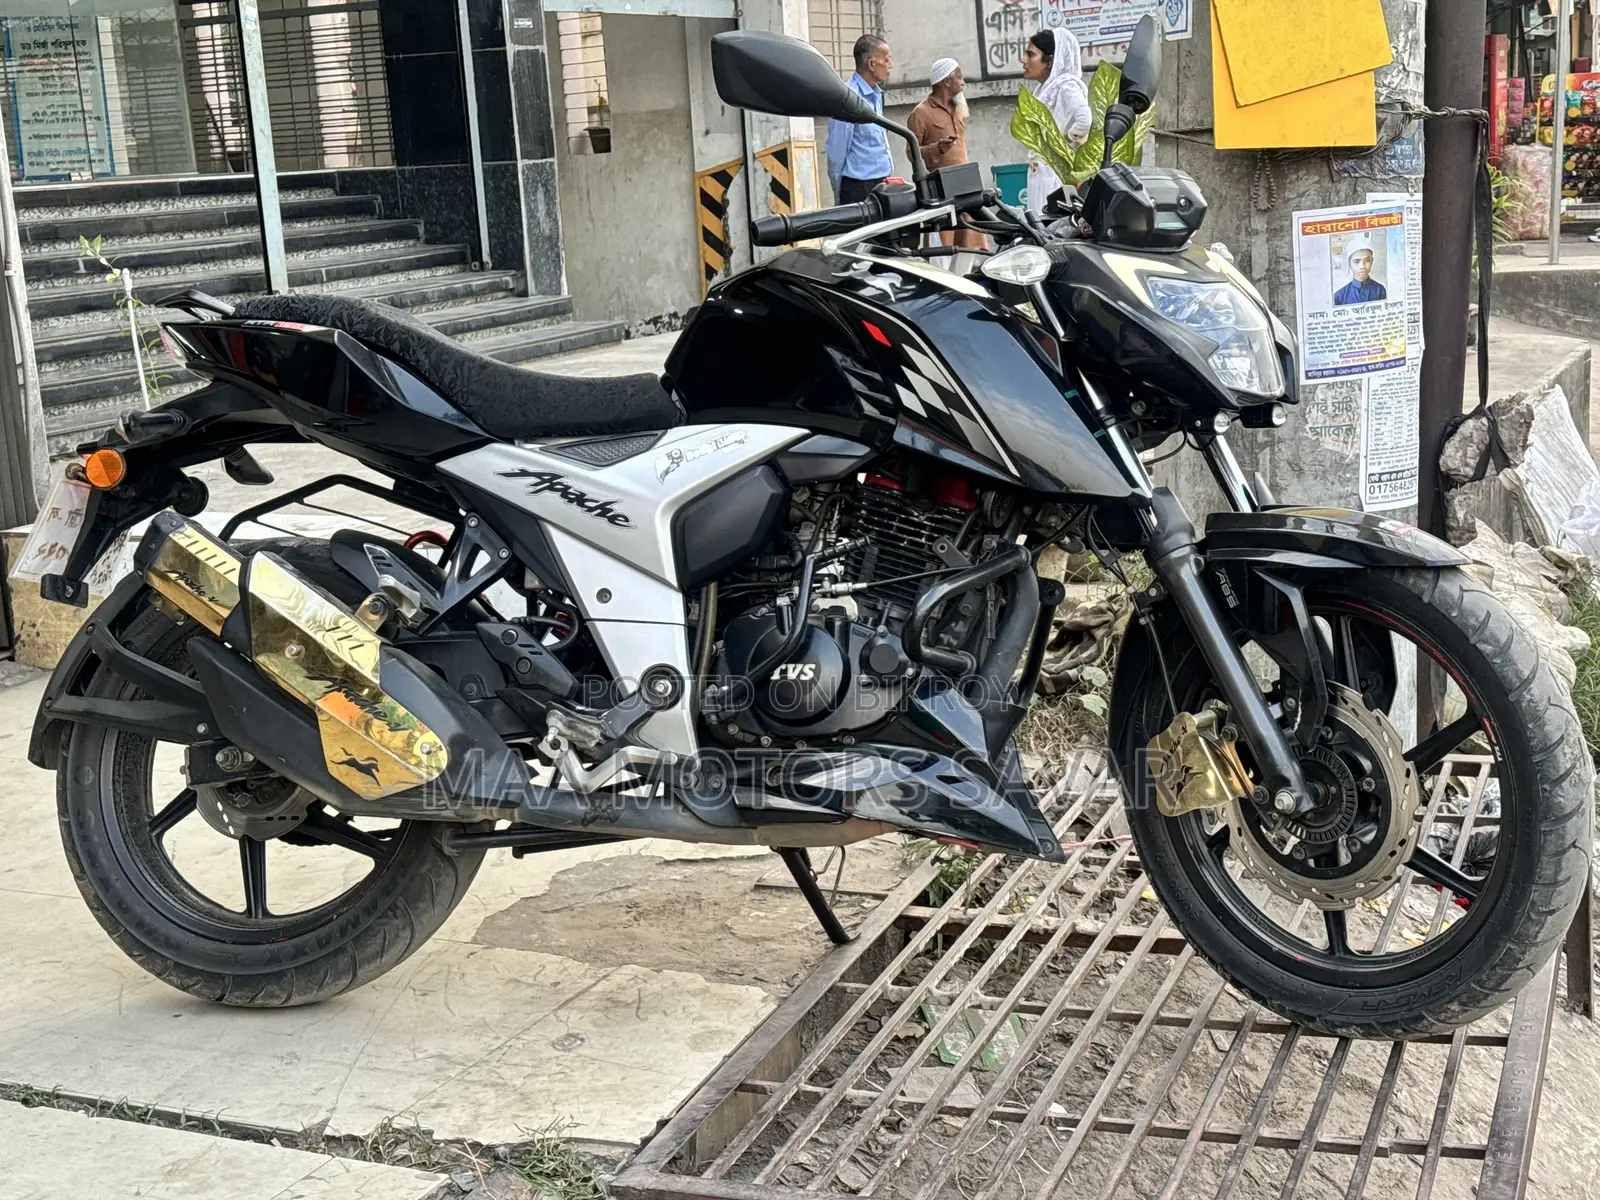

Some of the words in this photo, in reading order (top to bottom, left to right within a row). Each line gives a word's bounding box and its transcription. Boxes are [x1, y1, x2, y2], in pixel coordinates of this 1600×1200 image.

[1303, 219, 1360, 234] হারানো
[496, 468, 634, 528] Apache
[1215, 570, 1237, 609] ABS
[770, 663, 816, 681] TVS
